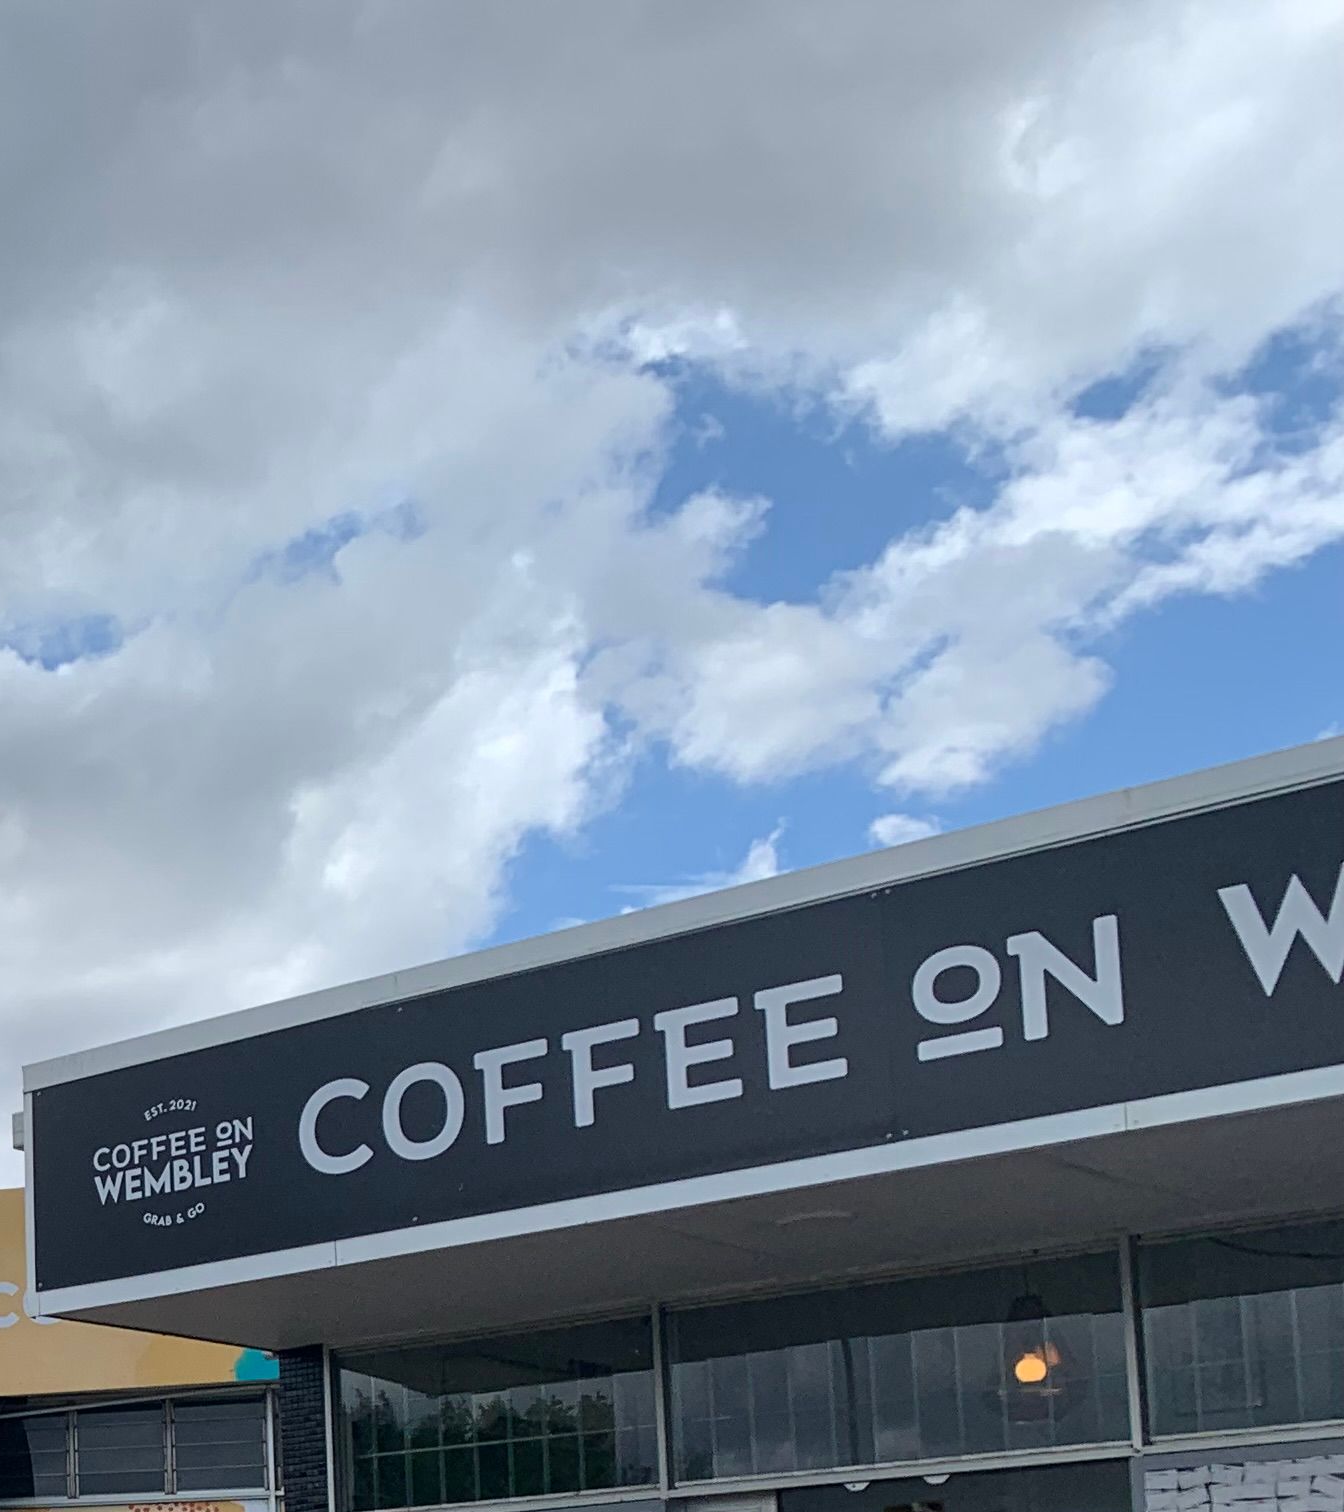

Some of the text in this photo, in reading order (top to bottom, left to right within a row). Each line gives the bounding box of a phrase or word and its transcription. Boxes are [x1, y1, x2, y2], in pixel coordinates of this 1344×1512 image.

[297, 972, 850, 1175] COFFEE
[911, 913, 1125, 1063] ON
[143, 1099, 198, 1122] EST. 2021
[92, 1116, 254, 1172] COFFEE ON
[93, 1143, 254, 1206] WEMBLEY
[142, 1202, 206, 1227] GRAB & GO
